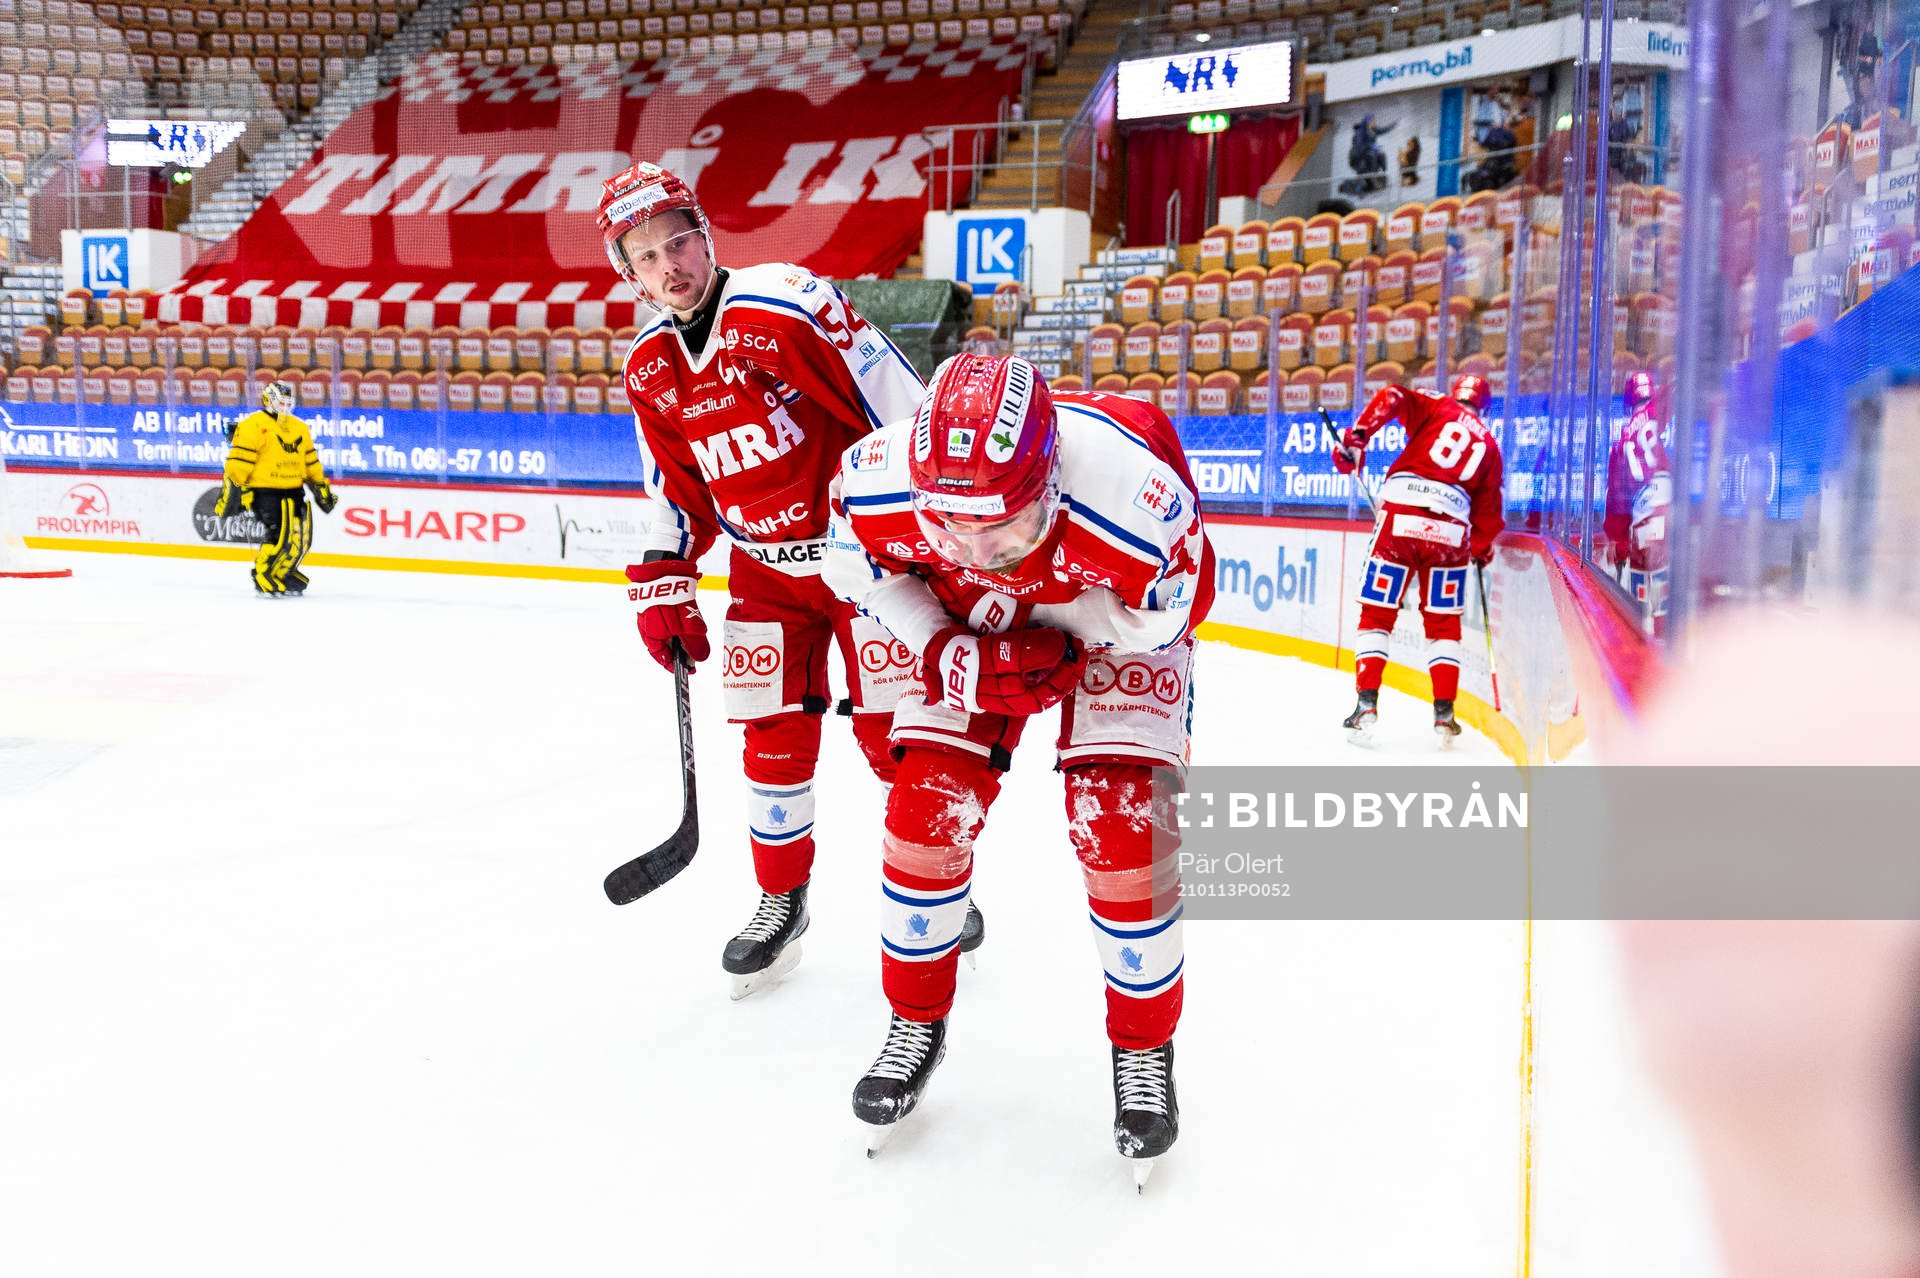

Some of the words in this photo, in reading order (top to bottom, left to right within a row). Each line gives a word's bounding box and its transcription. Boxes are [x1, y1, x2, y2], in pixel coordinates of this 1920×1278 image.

[1372, 45, 1473, 87] permobil
[1855, 137, 1878, 150] MAXI
[748, 129, 949, 207] IK
[1792, 210, 1808, 224] MAX
[88, 244, 122, 290] LK
[967, 228, 1014, 284] LK
[742, 333, 779, 352] SCA
[814, 301, 872, 351] 54
[638, 357, 669, 381] SCA
[999, 362, 1028, 429] LILIUM
[133, 411, 160, 432] AB
[688, 391, 805, 483] MRÅ
[1284, 422, 1316, 454] AB
[411, 447, 481, 473] 06-57
[489, 450, 512, 472] 10
[518, 451, 545, 475] 50
[949, 445, 970, 453] NHC
[1429, 421, 1486, 481] 81
[36, 516, 141, 536] PROLYMPIA
[344, 507, 526, 543] SHARP
[749, 502, 809, 535] NHC
[1068, 563, 1112, 588] SCA
[1218, 545, 1318, 612] mobil
